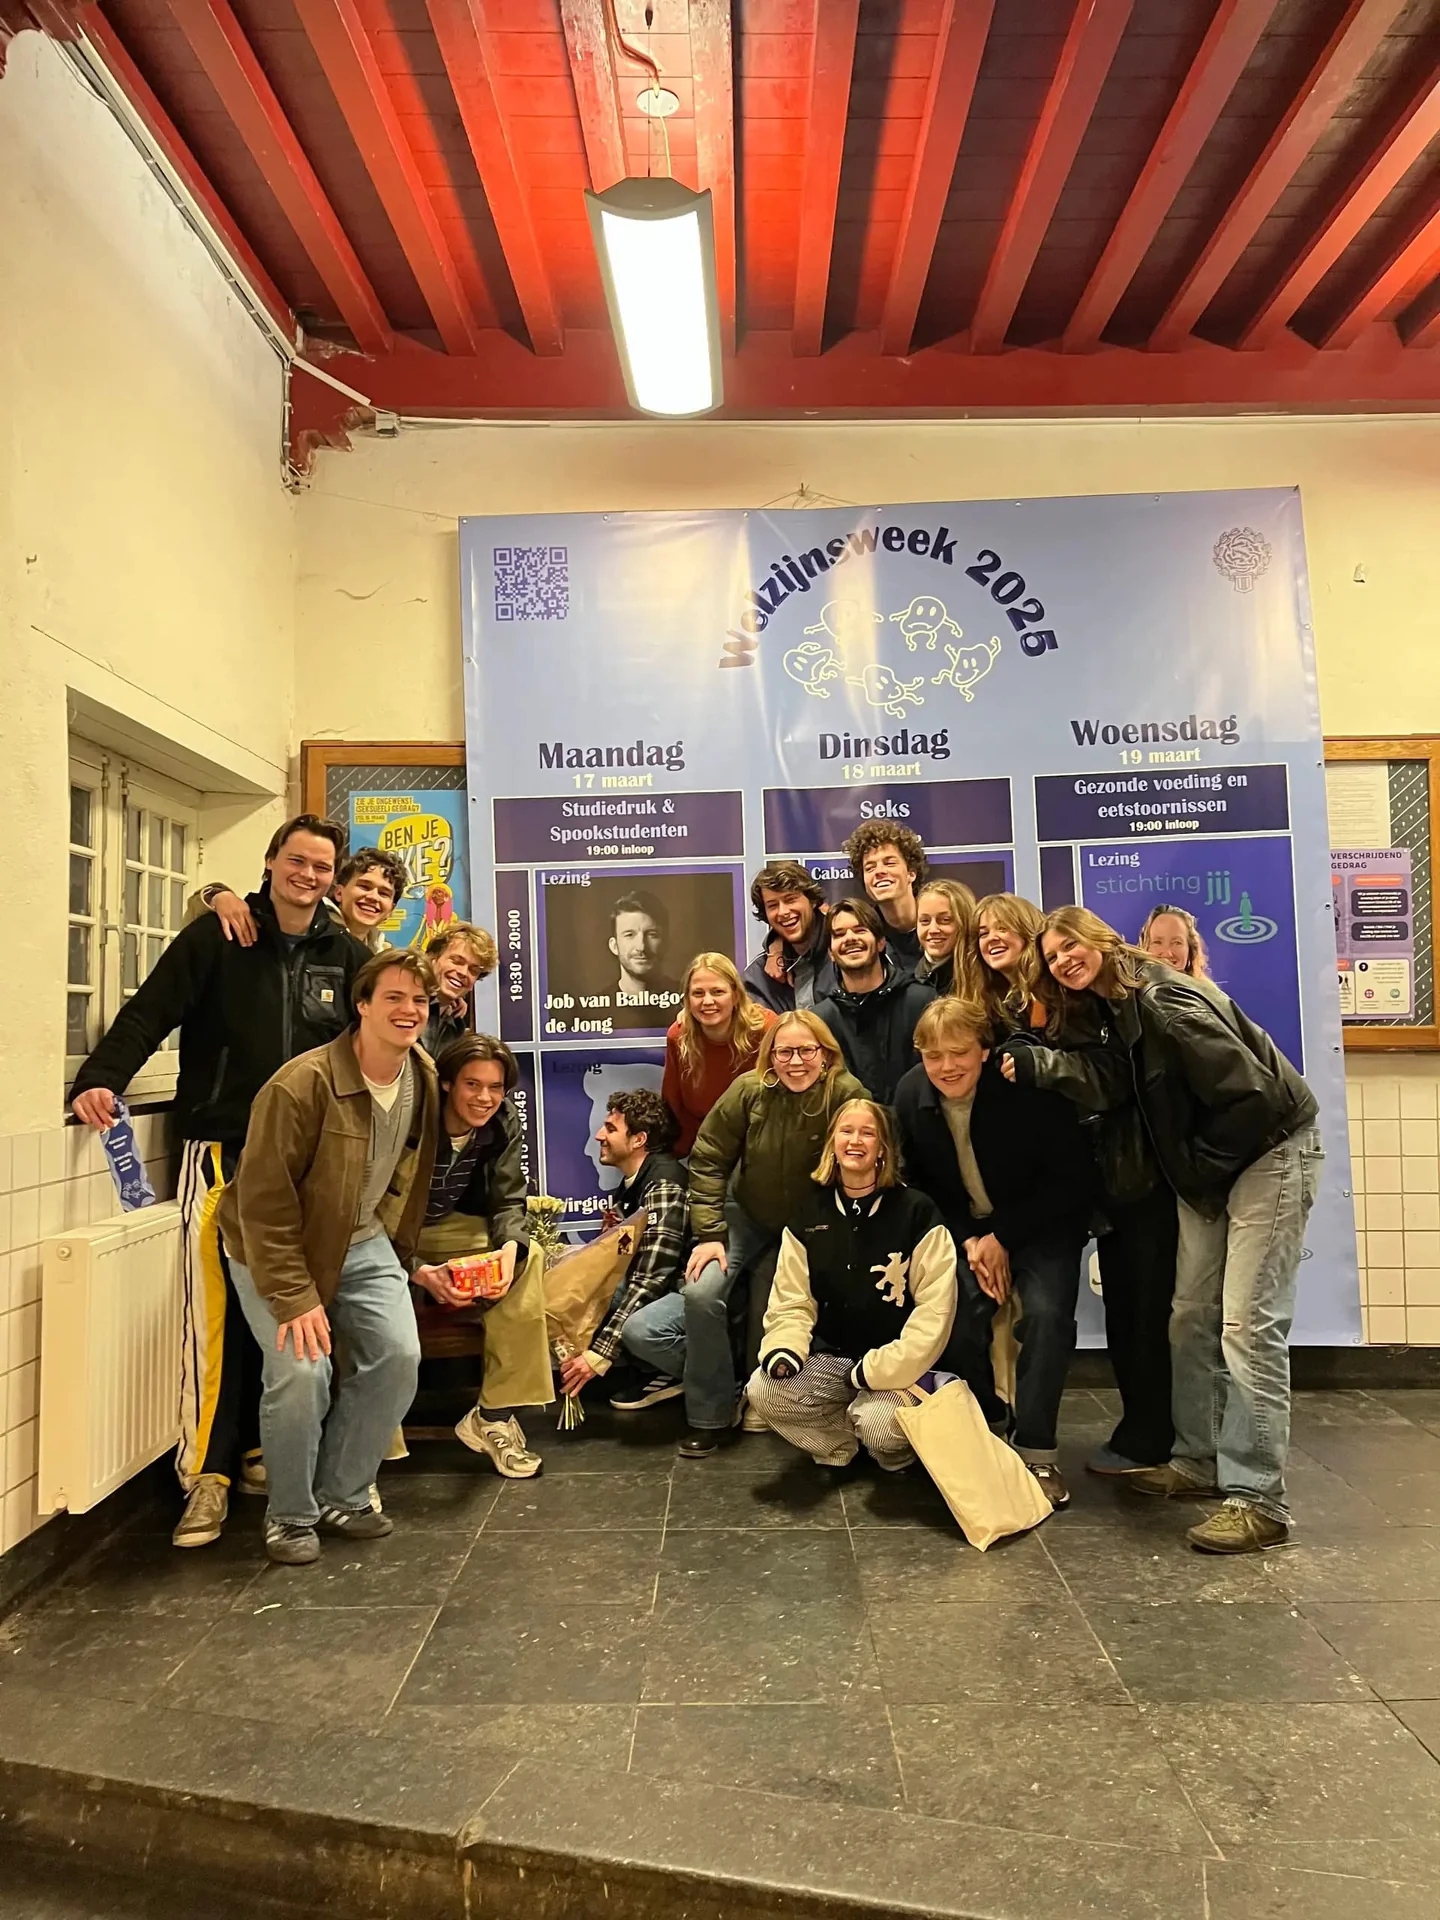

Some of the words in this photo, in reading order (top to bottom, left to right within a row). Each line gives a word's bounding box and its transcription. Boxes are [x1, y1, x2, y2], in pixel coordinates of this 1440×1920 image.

[719, 526, 958, 668] Welzijnsweek
[965, 549, 1059, 657] 2025
[1070, 714, 1240, 746] Woensdag
[819, 729, 951, 760] Dinsdag
[539, 740, 685, 772] Maandag
[1119, 749, 1142, 765] 19
[1149, 747, 1201, 764] maart
[842, 764, 864, 779] 18
[870, 762, 921, 777] maart
[572, 774, 595, 789] 17
[602, 772, 653, 788] maart
[1074, 778, 1148, 796] Gezonde
[1153, 774, 1222, 794] voeding
[1227, 775, 1247, 788] en
[562, 800, 656, 817] Studiedruk
[662, 799, 675, 814] &
[860, 800, 910, 818] Seks
[1098, 799, 1227, 818] eetstoornissen
[384, 825, 413, 849] BEN
[421, 819, 439, 840] JE
[550, 824, 688, 844] Spookstudenten
[1129, 820, 1162, 833] 19:00
[1165, 818, 1200, 832] inloop
[586, 845, 618, 857] 19:00
[621, 843, 654, 857] inloop
[1089, 852, 1140, 867] Lezing
[1330, 852, 1403, 860] VERSCHRIJDEND
[541, 871, 591, 887] Lezing
[1096, 872, 1200, 894] stichting
[1204, 870, 1231, 905] jij
[507, 909, 521, 950] 20:00
[510, 960, 523, 1002] 19:30
[544, 994, 574, 1009] Job
[579, 994, 610, 1008] van
[616, 990, 685, 1009] Ballego
[545, 1018, 567, 1034] de
[571, 1017, 613, 1035] Jong
